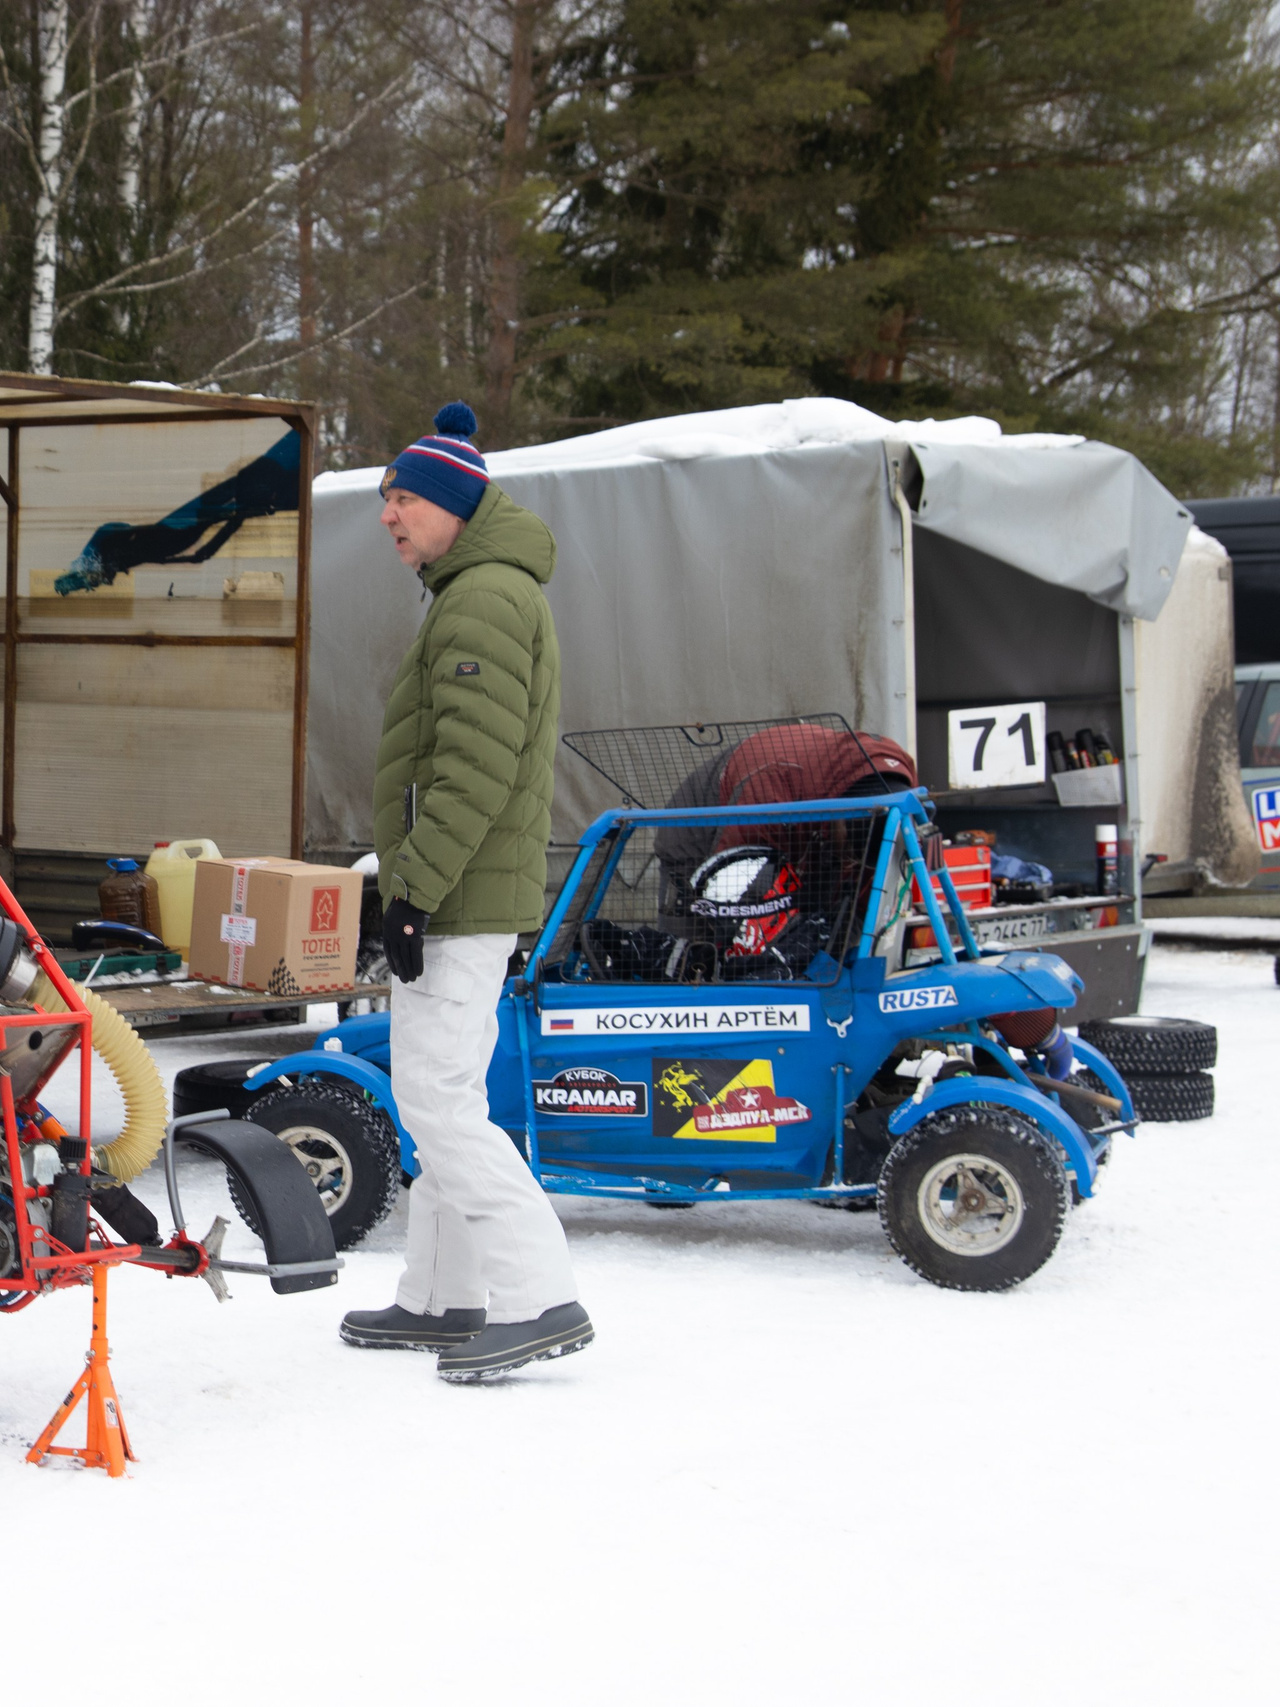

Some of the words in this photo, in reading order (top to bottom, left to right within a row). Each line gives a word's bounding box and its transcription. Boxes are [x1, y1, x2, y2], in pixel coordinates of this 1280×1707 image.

[959, 712, 1036, 772] 71
[301, 937, 341, 954] TOTEK
[882, 988, 957, 1011] RUSTA
[596, 1012, 708, 1030] КОСУХИН
[716, 1006, 798, 1028] АРТЁМ
[565, 1070, 607, 1082] КУБОК
[536, 1088, 637, 1106] KRAMAR
[567, 1105, 637, 1113] MOTORSPORT
